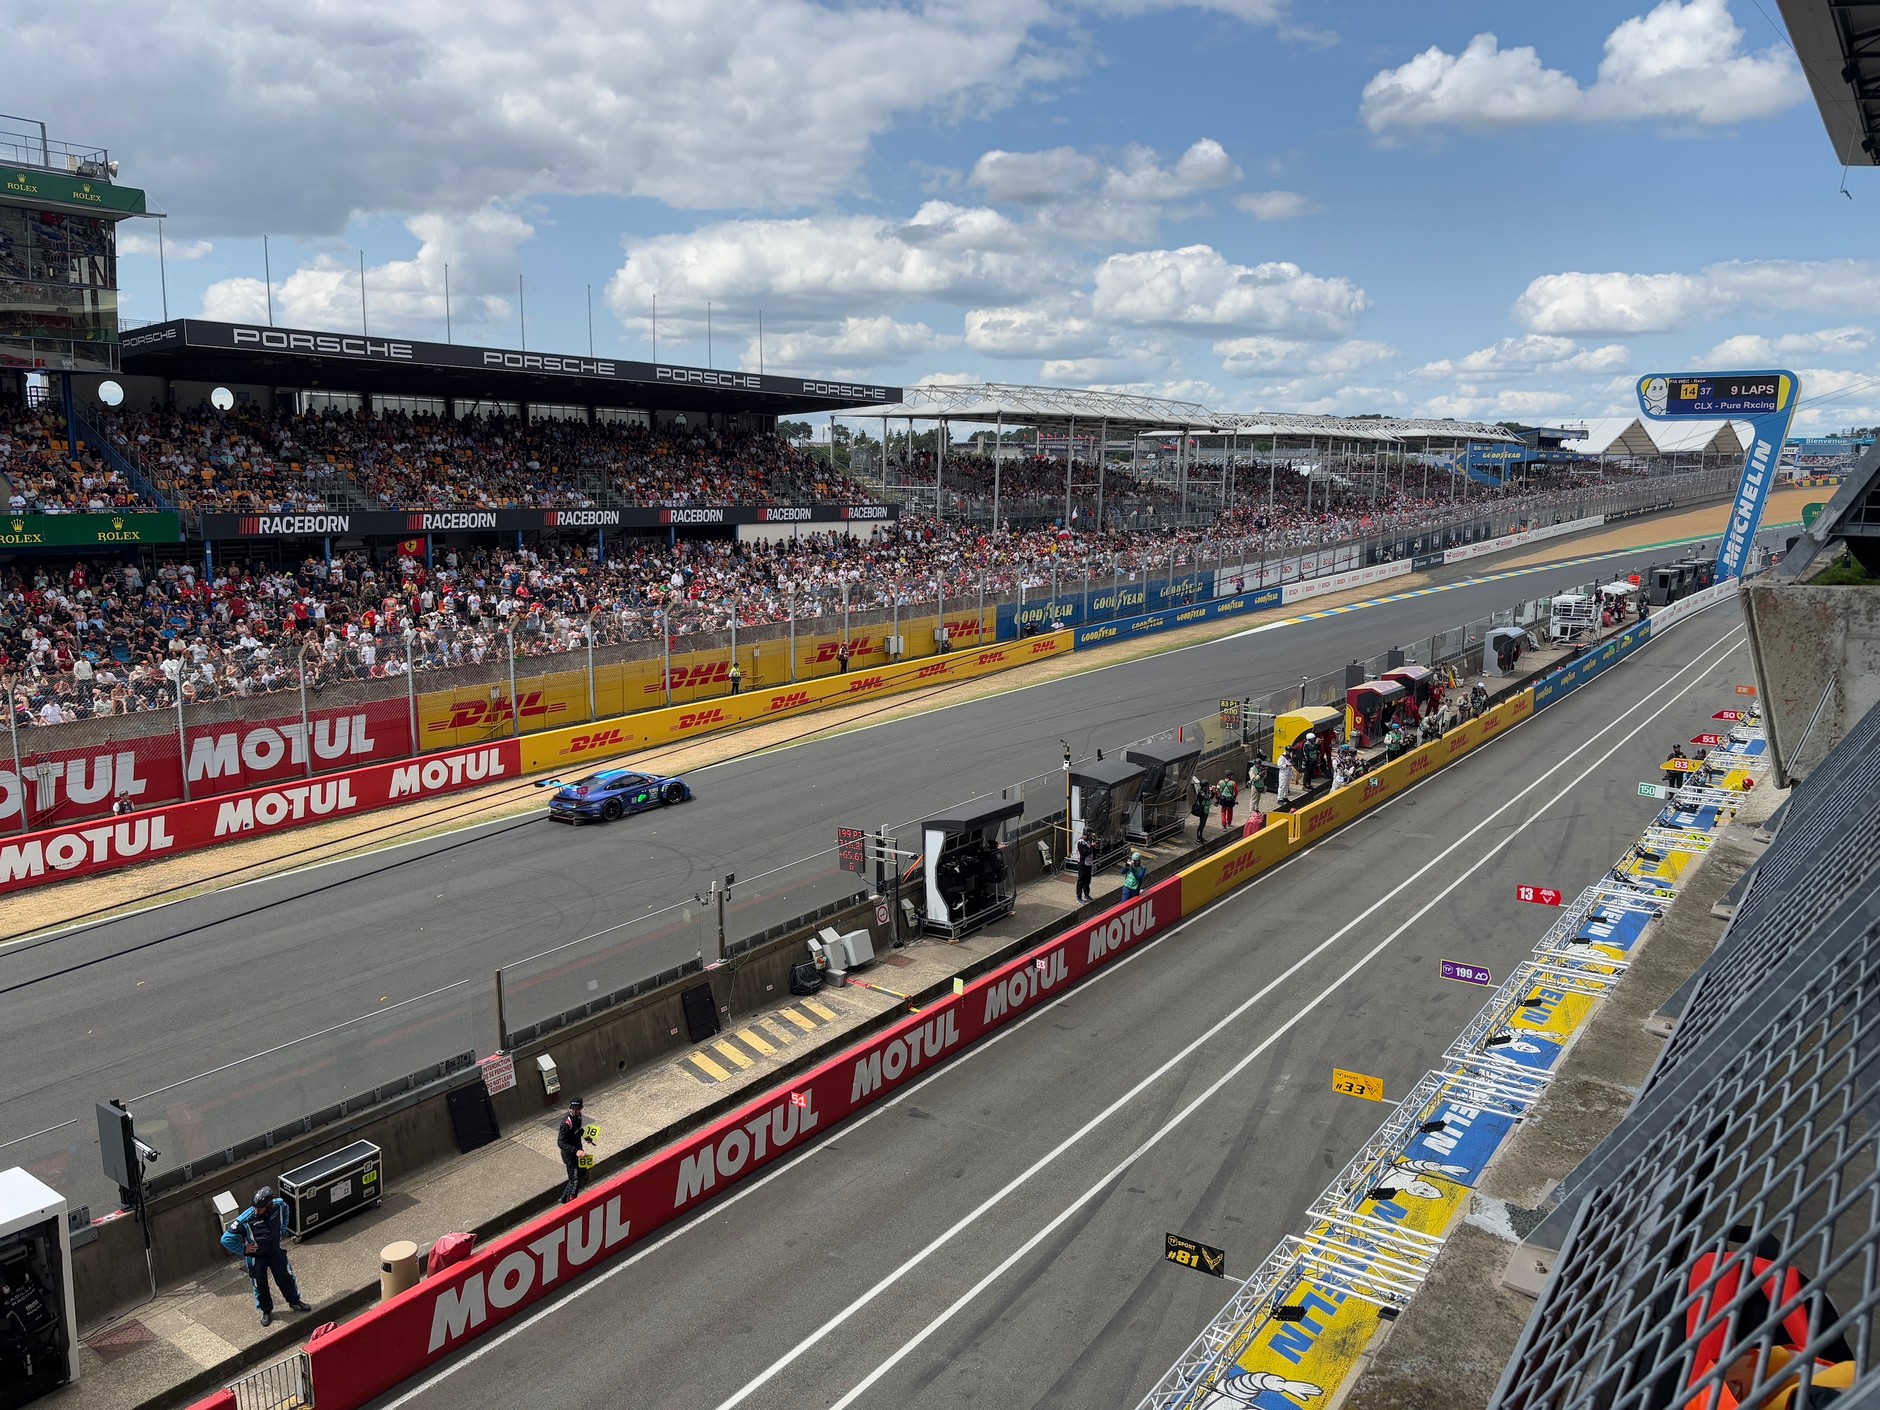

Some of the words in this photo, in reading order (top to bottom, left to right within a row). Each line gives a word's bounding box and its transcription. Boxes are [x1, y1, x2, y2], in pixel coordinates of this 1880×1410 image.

[7, 182, 38, 193] ROLEX
[72, 191, 102, 202] ROLEX
[122, 328, 177, 349] PORSCHE
[233, 328, 413, 359] PORSCHE
[483, 351, 616, 376] PORSCHE
[656, 367, 761, 389] PORSCHE
[803, 381, 886, 399] PORSCHE
[1683, 387, 1696, 396] 14
[1730, 386, 1737, 395] 9
[1741, 385, 1775, 395] LAPS
[1694, 402, 1713, 410] CLX
[1720, 402, 1741, 410] Pure
[1743, 401, 1775, 411] Rxcing
[1482, 451, 1521, 459] GOODYEAR
[1722, 439, 1772, 568] MICHELIN
[557, 510, 620, 526] RACEBORN
[670, 509, 723, 523] RACEBORN
[766, 508, 812, 521] RACEBORN
[848, 506, 888, 519] RACEBORN
[259, 515, 349, 534] RACEBORN
[422, 512, 497, 530] RACEBORN
[0, 534, 43, 544] ROLEX
[97, 530, 141, 541] ROLEX
[1093, 590, 1144, 610] GOODYEAR
[1217, 598, 1244, 613] GOODYEAR
[1254, 591, 1279, 605] GOODYEAR
[1014, 602, 1073, 625] GOODYEAR
[1176, 607, 1206, 622] GOODYEAR
[944, 618, 988, 639] DHL
[1081, 626, 1117, 642] GOODYEAR
[816, 636, 874, 663] DHL
[1032, 640, 1056, 654] DHL
[978, 651, 1006, 665] DHL
[660, 660, 731, 691] DHL
[918, 662, 949, 678] DHL
[850, 676, 884, 694] DHL
[770, 691, 810, 711] DHL
[448, 691, 549, 728] DHL
[1722, 711, 1736, 719] 50
[678, 708, 725, 730] DHL
[569, 728, 625, 753] DHL
[1702, 735, 1715, 743] 51
[188, 714, 376, 781] MOTUL
[1674, 761, 1688, 769] 83
[388, 748, 505, 799] MOTUL
[1639, 785, 1656, 795] 150
[214, 778, 357, 836] MOTUL
[1308, 806, 1334, 833] DHL
[838, 828, 852, 838] 199
[0, 815, 174, 882] MOTUL
[839, 850, 864, 862] +65.62
[849, 862, 854, 870] 6
[1222, 849, 1255, 883] DHL
[1519, 887, 1534, 900] 13
[1087, 899, 1156, 964] MOTUL
[1036, 960, 1046, 969] 83
[1456, 967, 1473, 978] 199
[983, 947, 1069, 1025] MOTUL
[850, 1008, 960, 1104] MOTUL
[483, 1057, 511, 1073] INTERDICTION
[483, 1072, 489, 1080] DE
[488, 1070, 494, 1078] SE
[492, 1078, 502, 1086] NOT
[501, 1074, 512, 1083] LEAN
[489, 1081, 511, 1094] FORWARD
[1336, 1081, 1366, 1095] #33
[791, 1093, 806, 1106] 51
[674, 1088, 819, 1208] MOTUL
[1177, 1240, 1196, 1251] SPORT
[1167, 1249, 1199, 1267] #81
[427, 1194, 631, 1354] MOTUL
